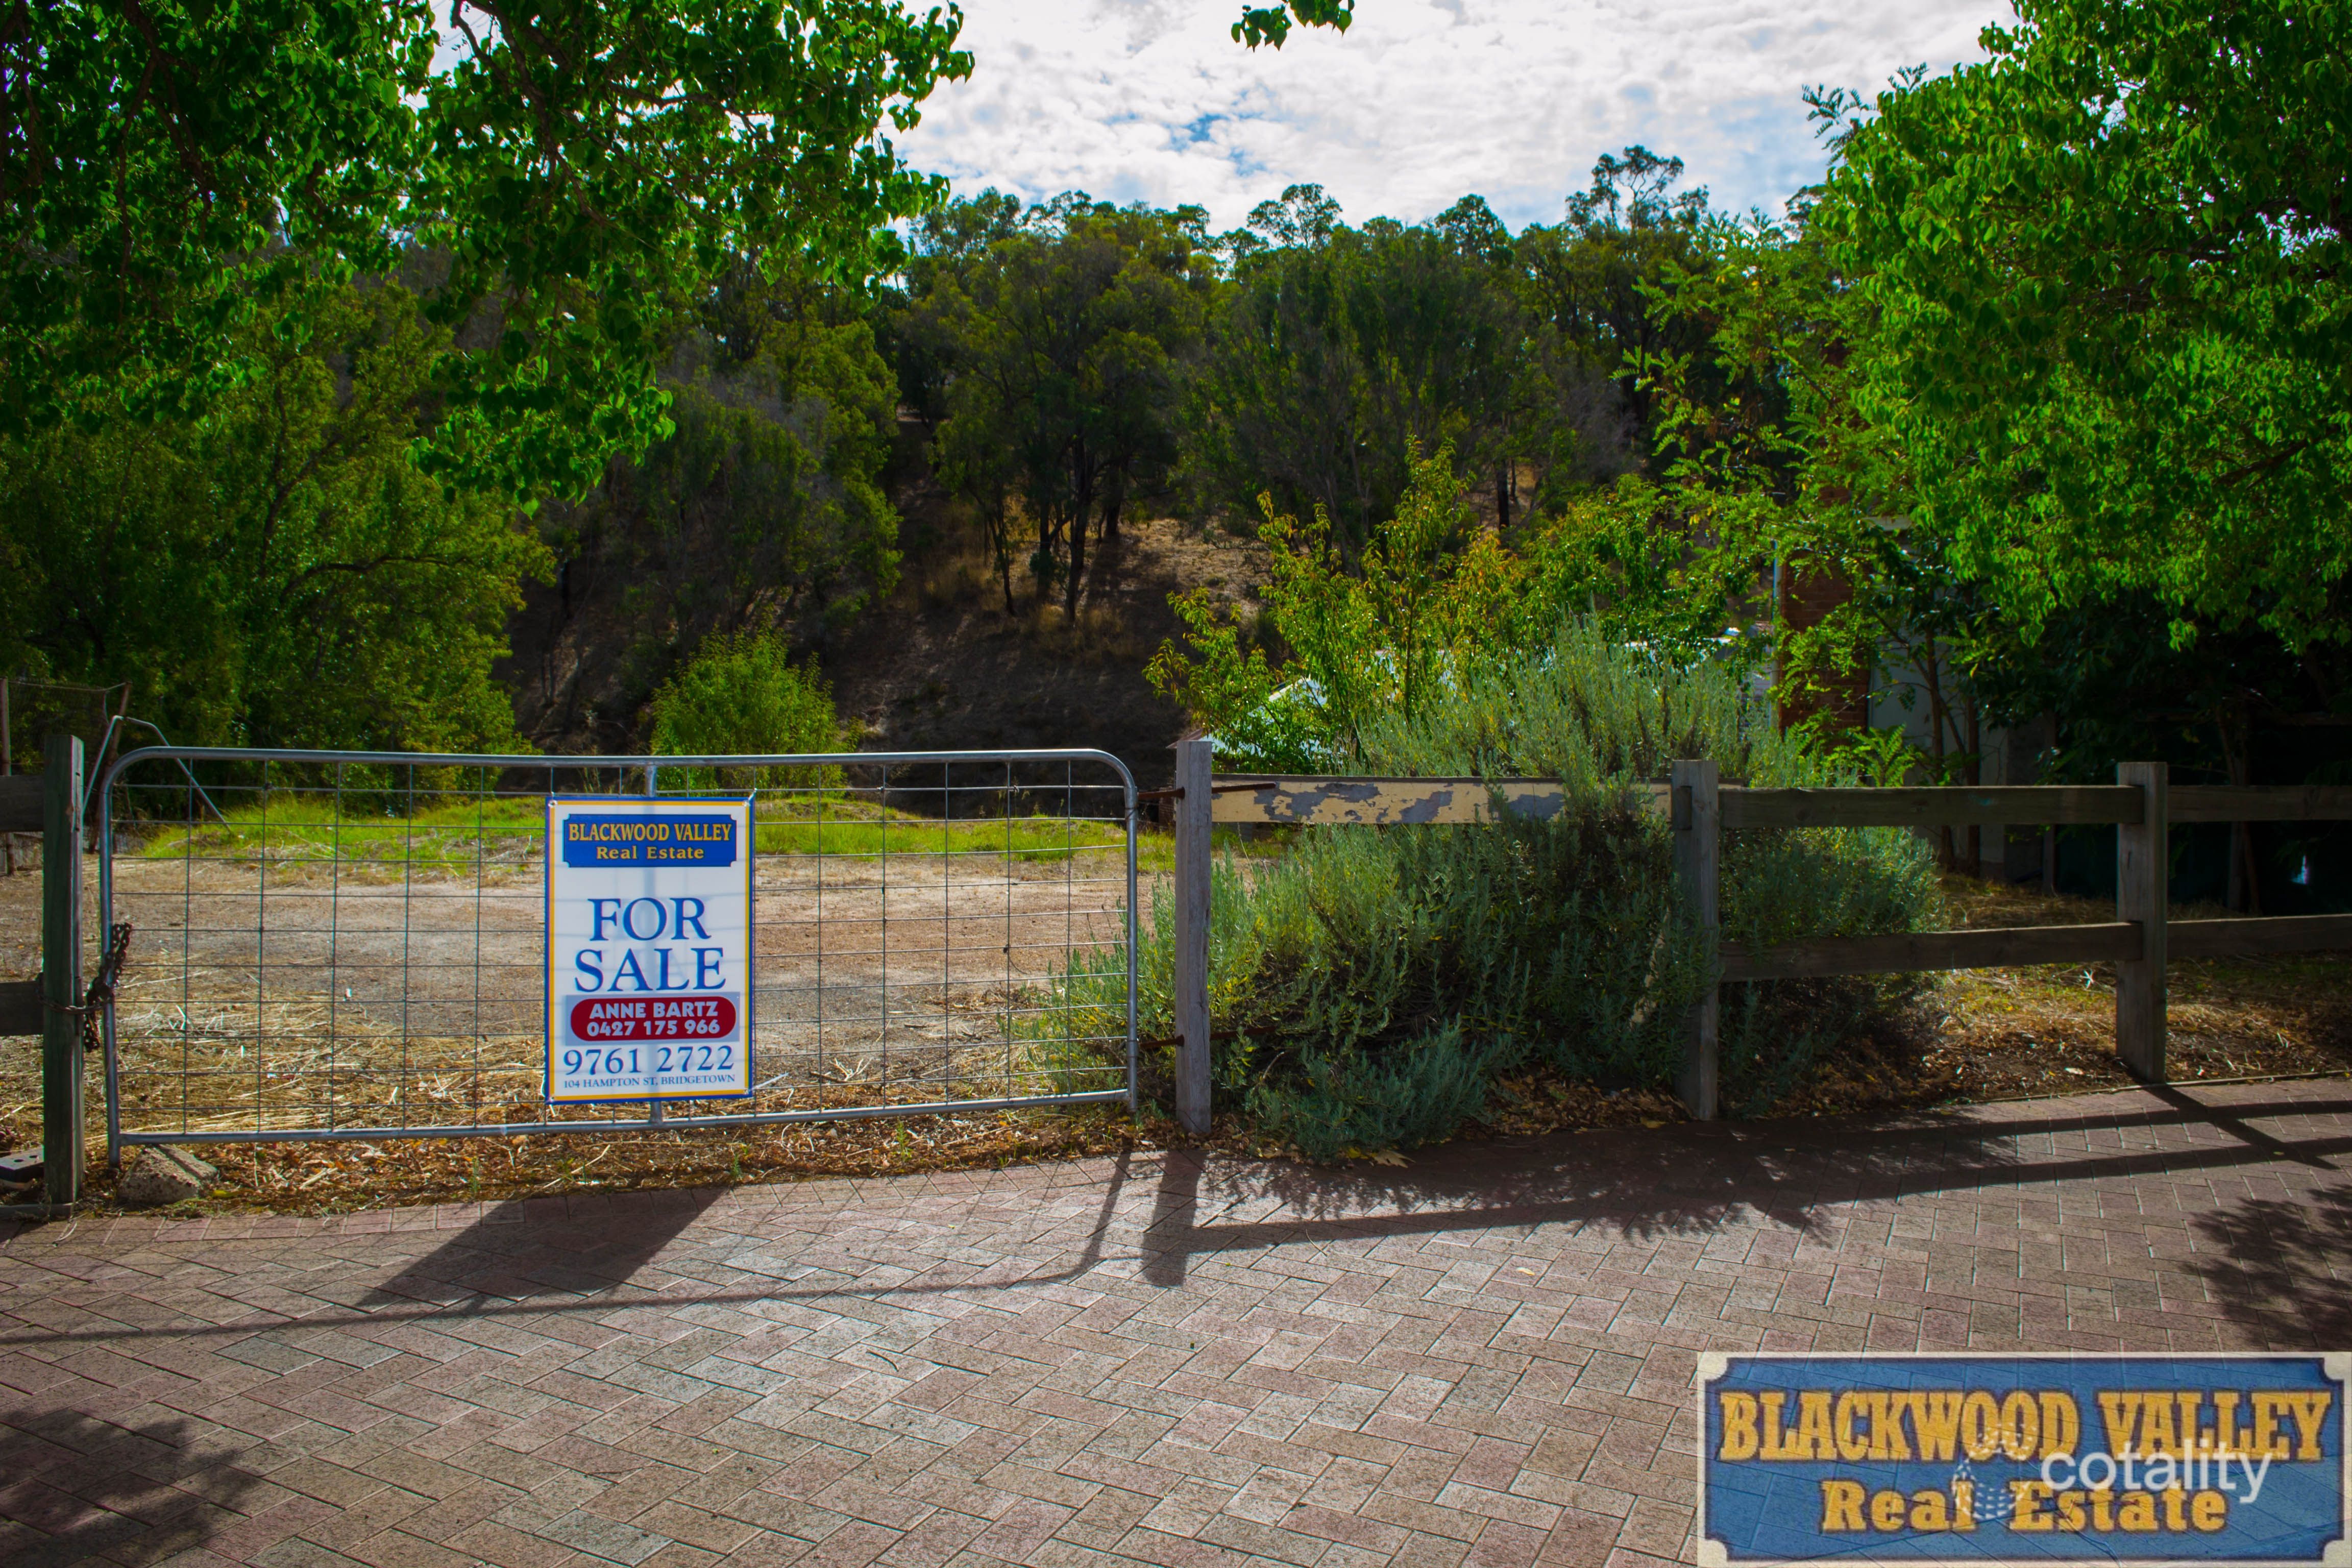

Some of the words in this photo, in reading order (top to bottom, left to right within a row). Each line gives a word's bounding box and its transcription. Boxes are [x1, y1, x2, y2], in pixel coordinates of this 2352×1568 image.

[569, 823, 670, 841] BLACKWOOD
[675, 823, 732, 841] VALLEY
[596, 846, 638, 860] Real
[647, 846, 704, 860] Estate
[587, 897, 712, 941] FOR
[574, 947, 726, 992] SALE
[589, 1002, 646, 1019] ANNE
[653, 1001, 718, 1018] BARTZ
[587, 1021, 635, 1036] 0427
[644, 1020, 677, 1035] 175
[684, 1020, 720, 1035] 966
[563, 1048, 642, 1076] 9761
[656, 1045, 734, 1072] 2722
[564, 1080, 580, 1088] 104
[583, 1078, 640, 1088] HAMPTON
[643, 1077, 658, 1086] ST,
[660, 1074, 736, 1085] BRIDGETOWN
